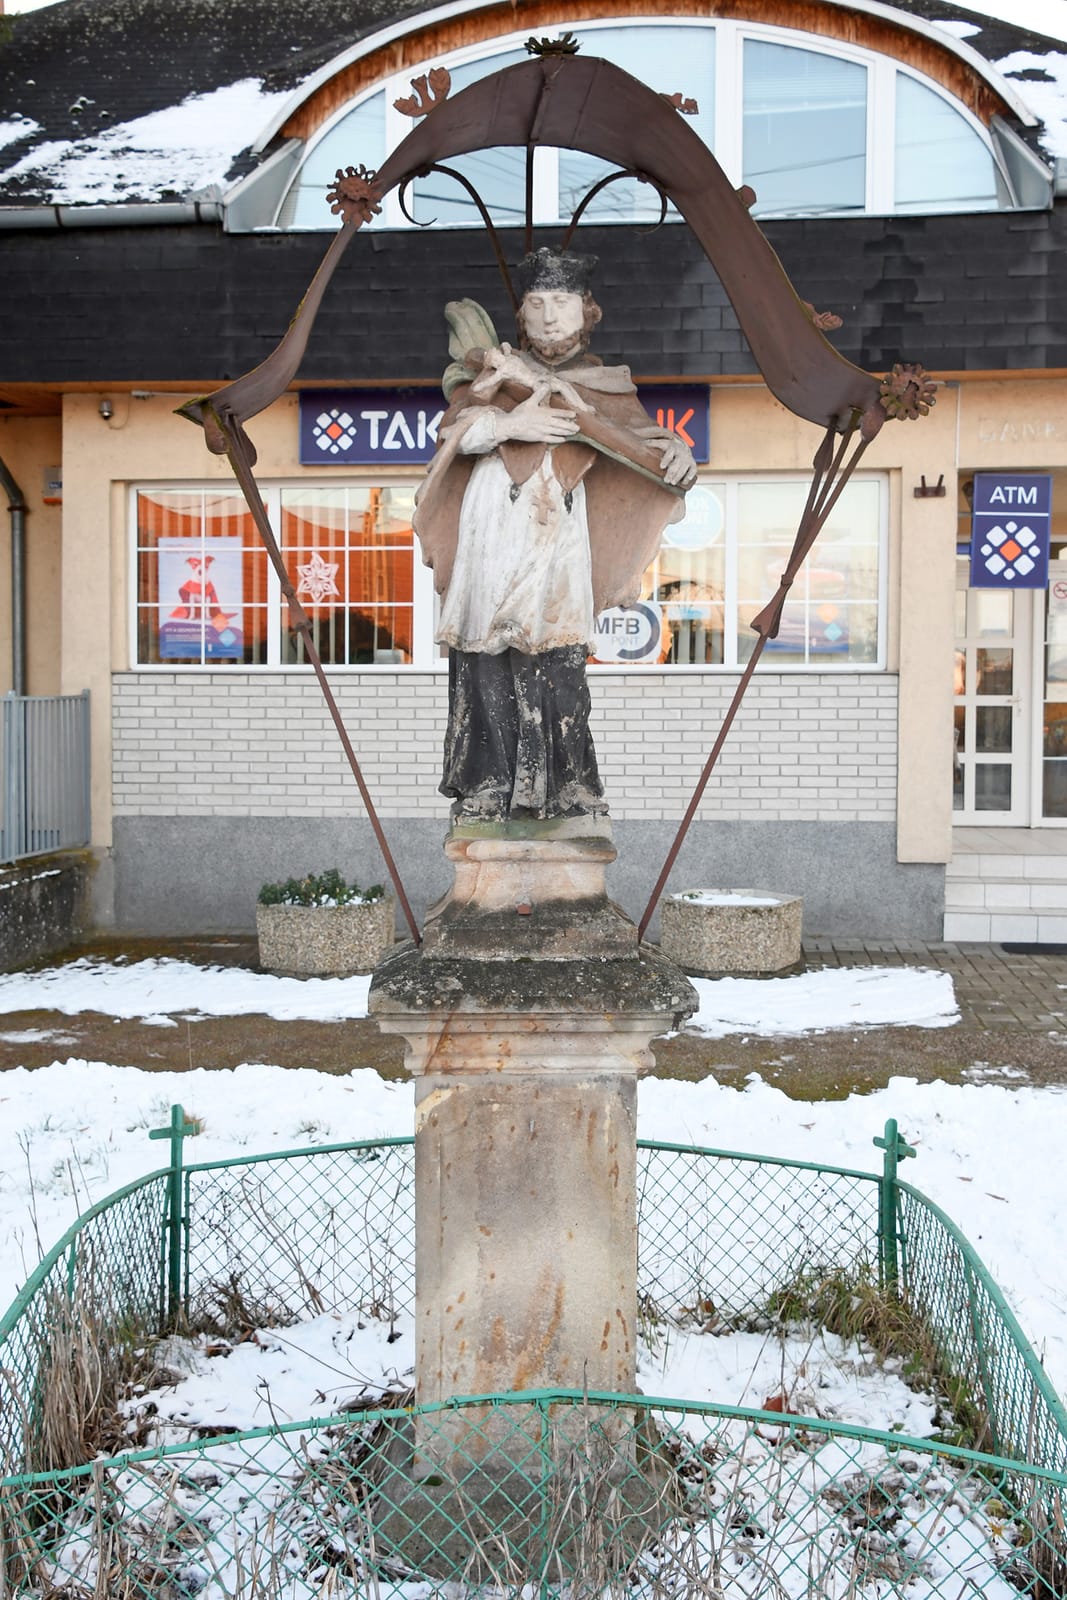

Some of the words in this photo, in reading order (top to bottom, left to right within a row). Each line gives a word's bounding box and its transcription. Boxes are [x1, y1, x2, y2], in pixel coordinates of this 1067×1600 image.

[989, 486, 1037, 504] ATM
[593, 617, 640, 635] MFB
[611, 636, 641, 646] PONT
